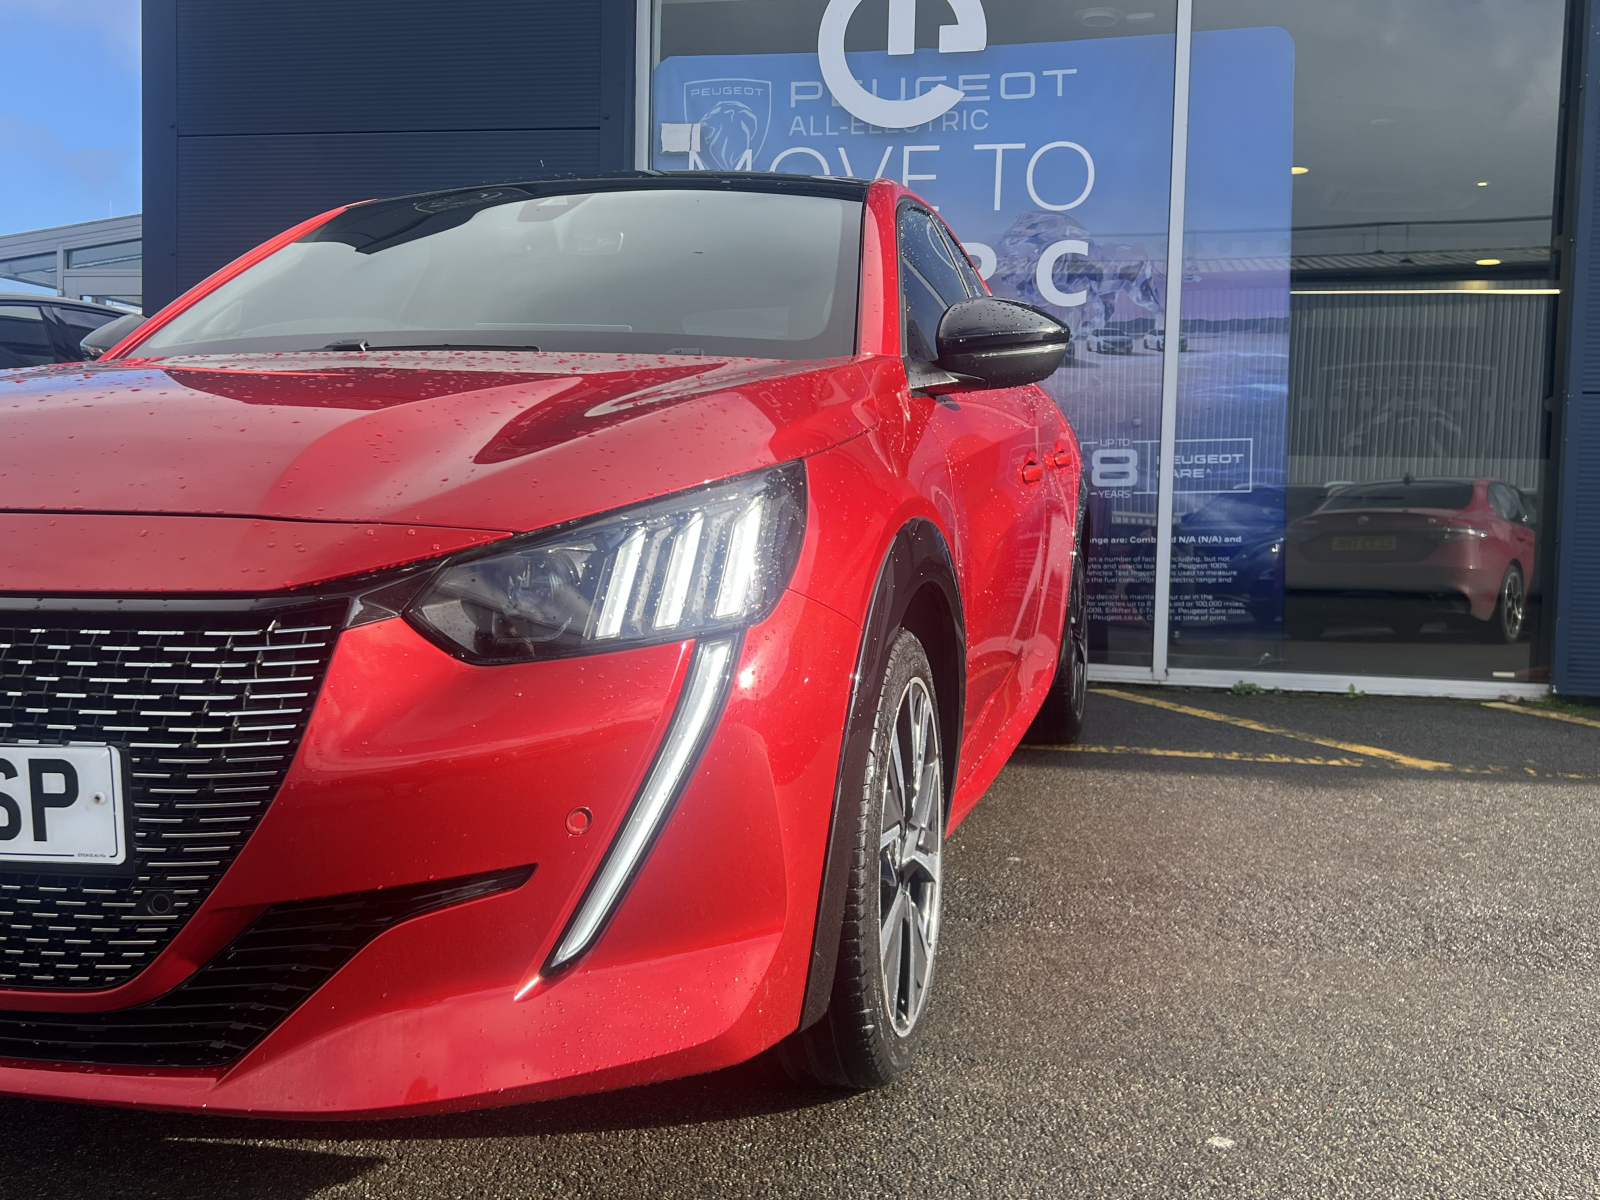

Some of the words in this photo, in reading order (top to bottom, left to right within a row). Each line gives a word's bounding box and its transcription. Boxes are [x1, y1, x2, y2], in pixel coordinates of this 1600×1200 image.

[691, 87, 763, 97] PEUGEOT
[790, 68, 1078, 108] PUGEOT
[973, 140, 1095, 211] TO
[1117, 438, 1130, 446] TO
[1157, 454, 1244, 464] EUGEOT
[1091, 449, 1138, 487] 8
[1157, 468, 1211, 478] ARE^
[1098, 490, 1131, 499] YEARS
[1198, 535, 1221, 545] (N/A)
